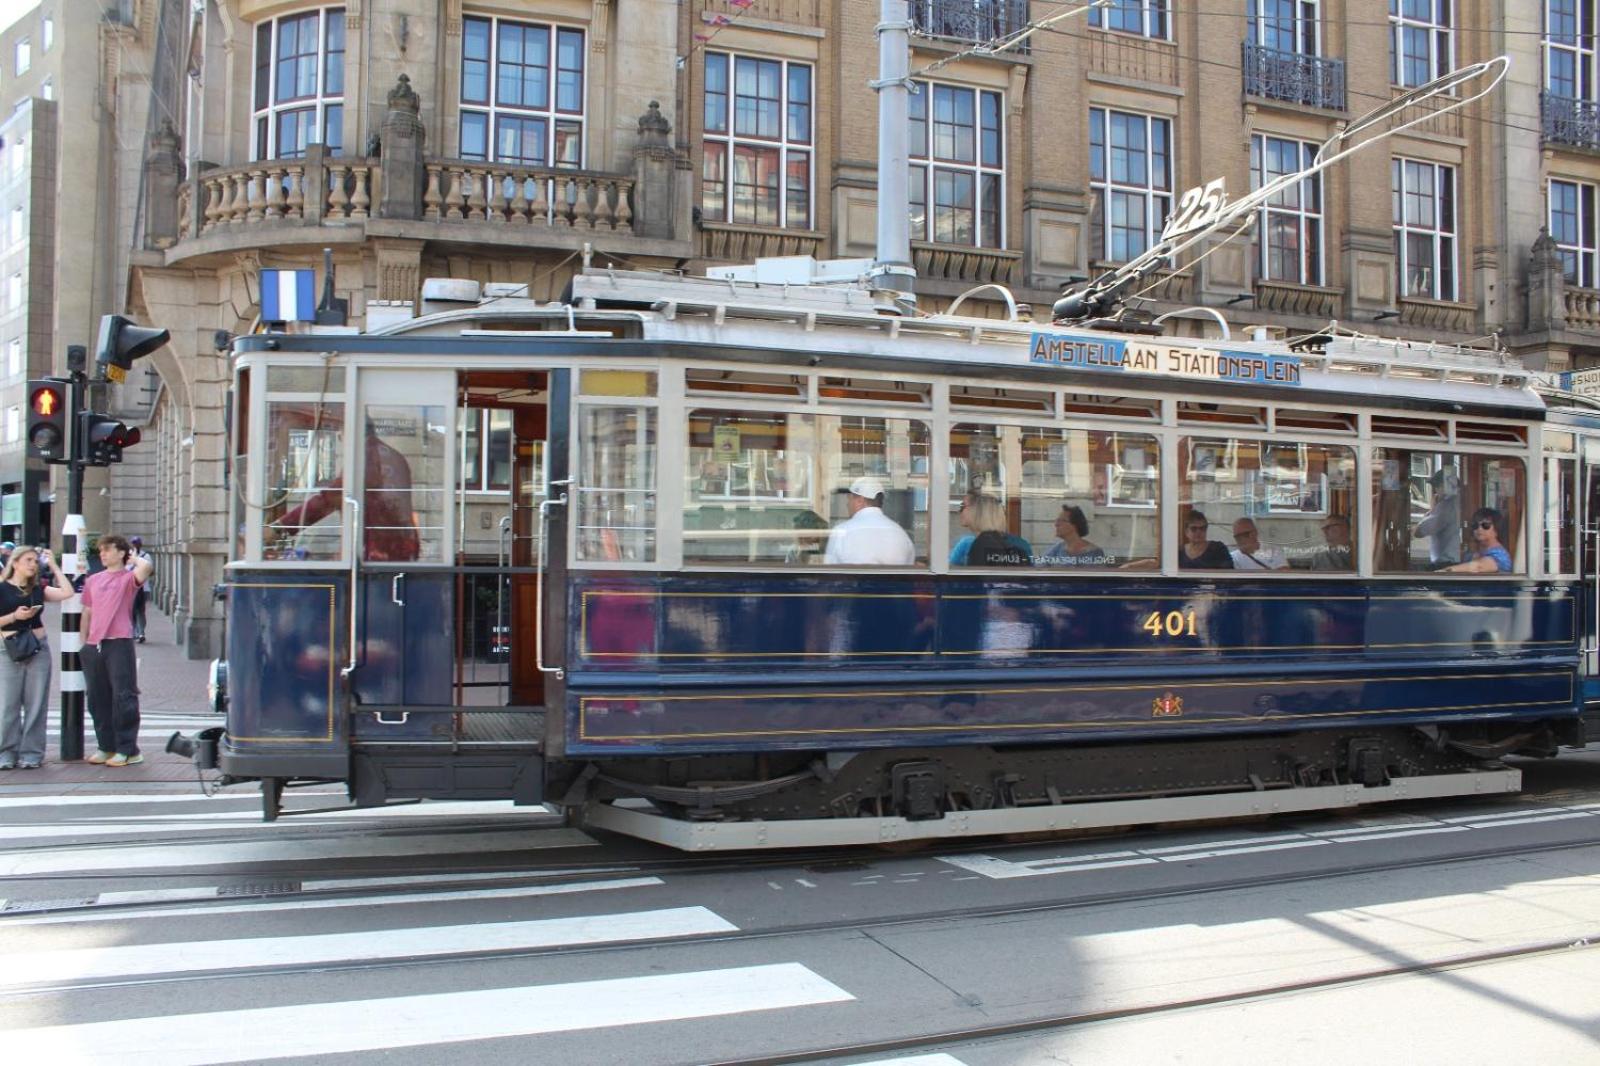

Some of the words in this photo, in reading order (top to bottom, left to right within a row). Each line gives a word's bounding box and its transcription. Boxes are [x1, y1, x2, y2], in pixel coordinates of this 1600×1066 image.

[1162, 176, 1225, 240] 25
[1033, 335, 1158, 370] AMSTELLAAN
[1168, 349, 1301, 383] STATIONSPLEIN
[1143, 610, 1198, 636] 401
